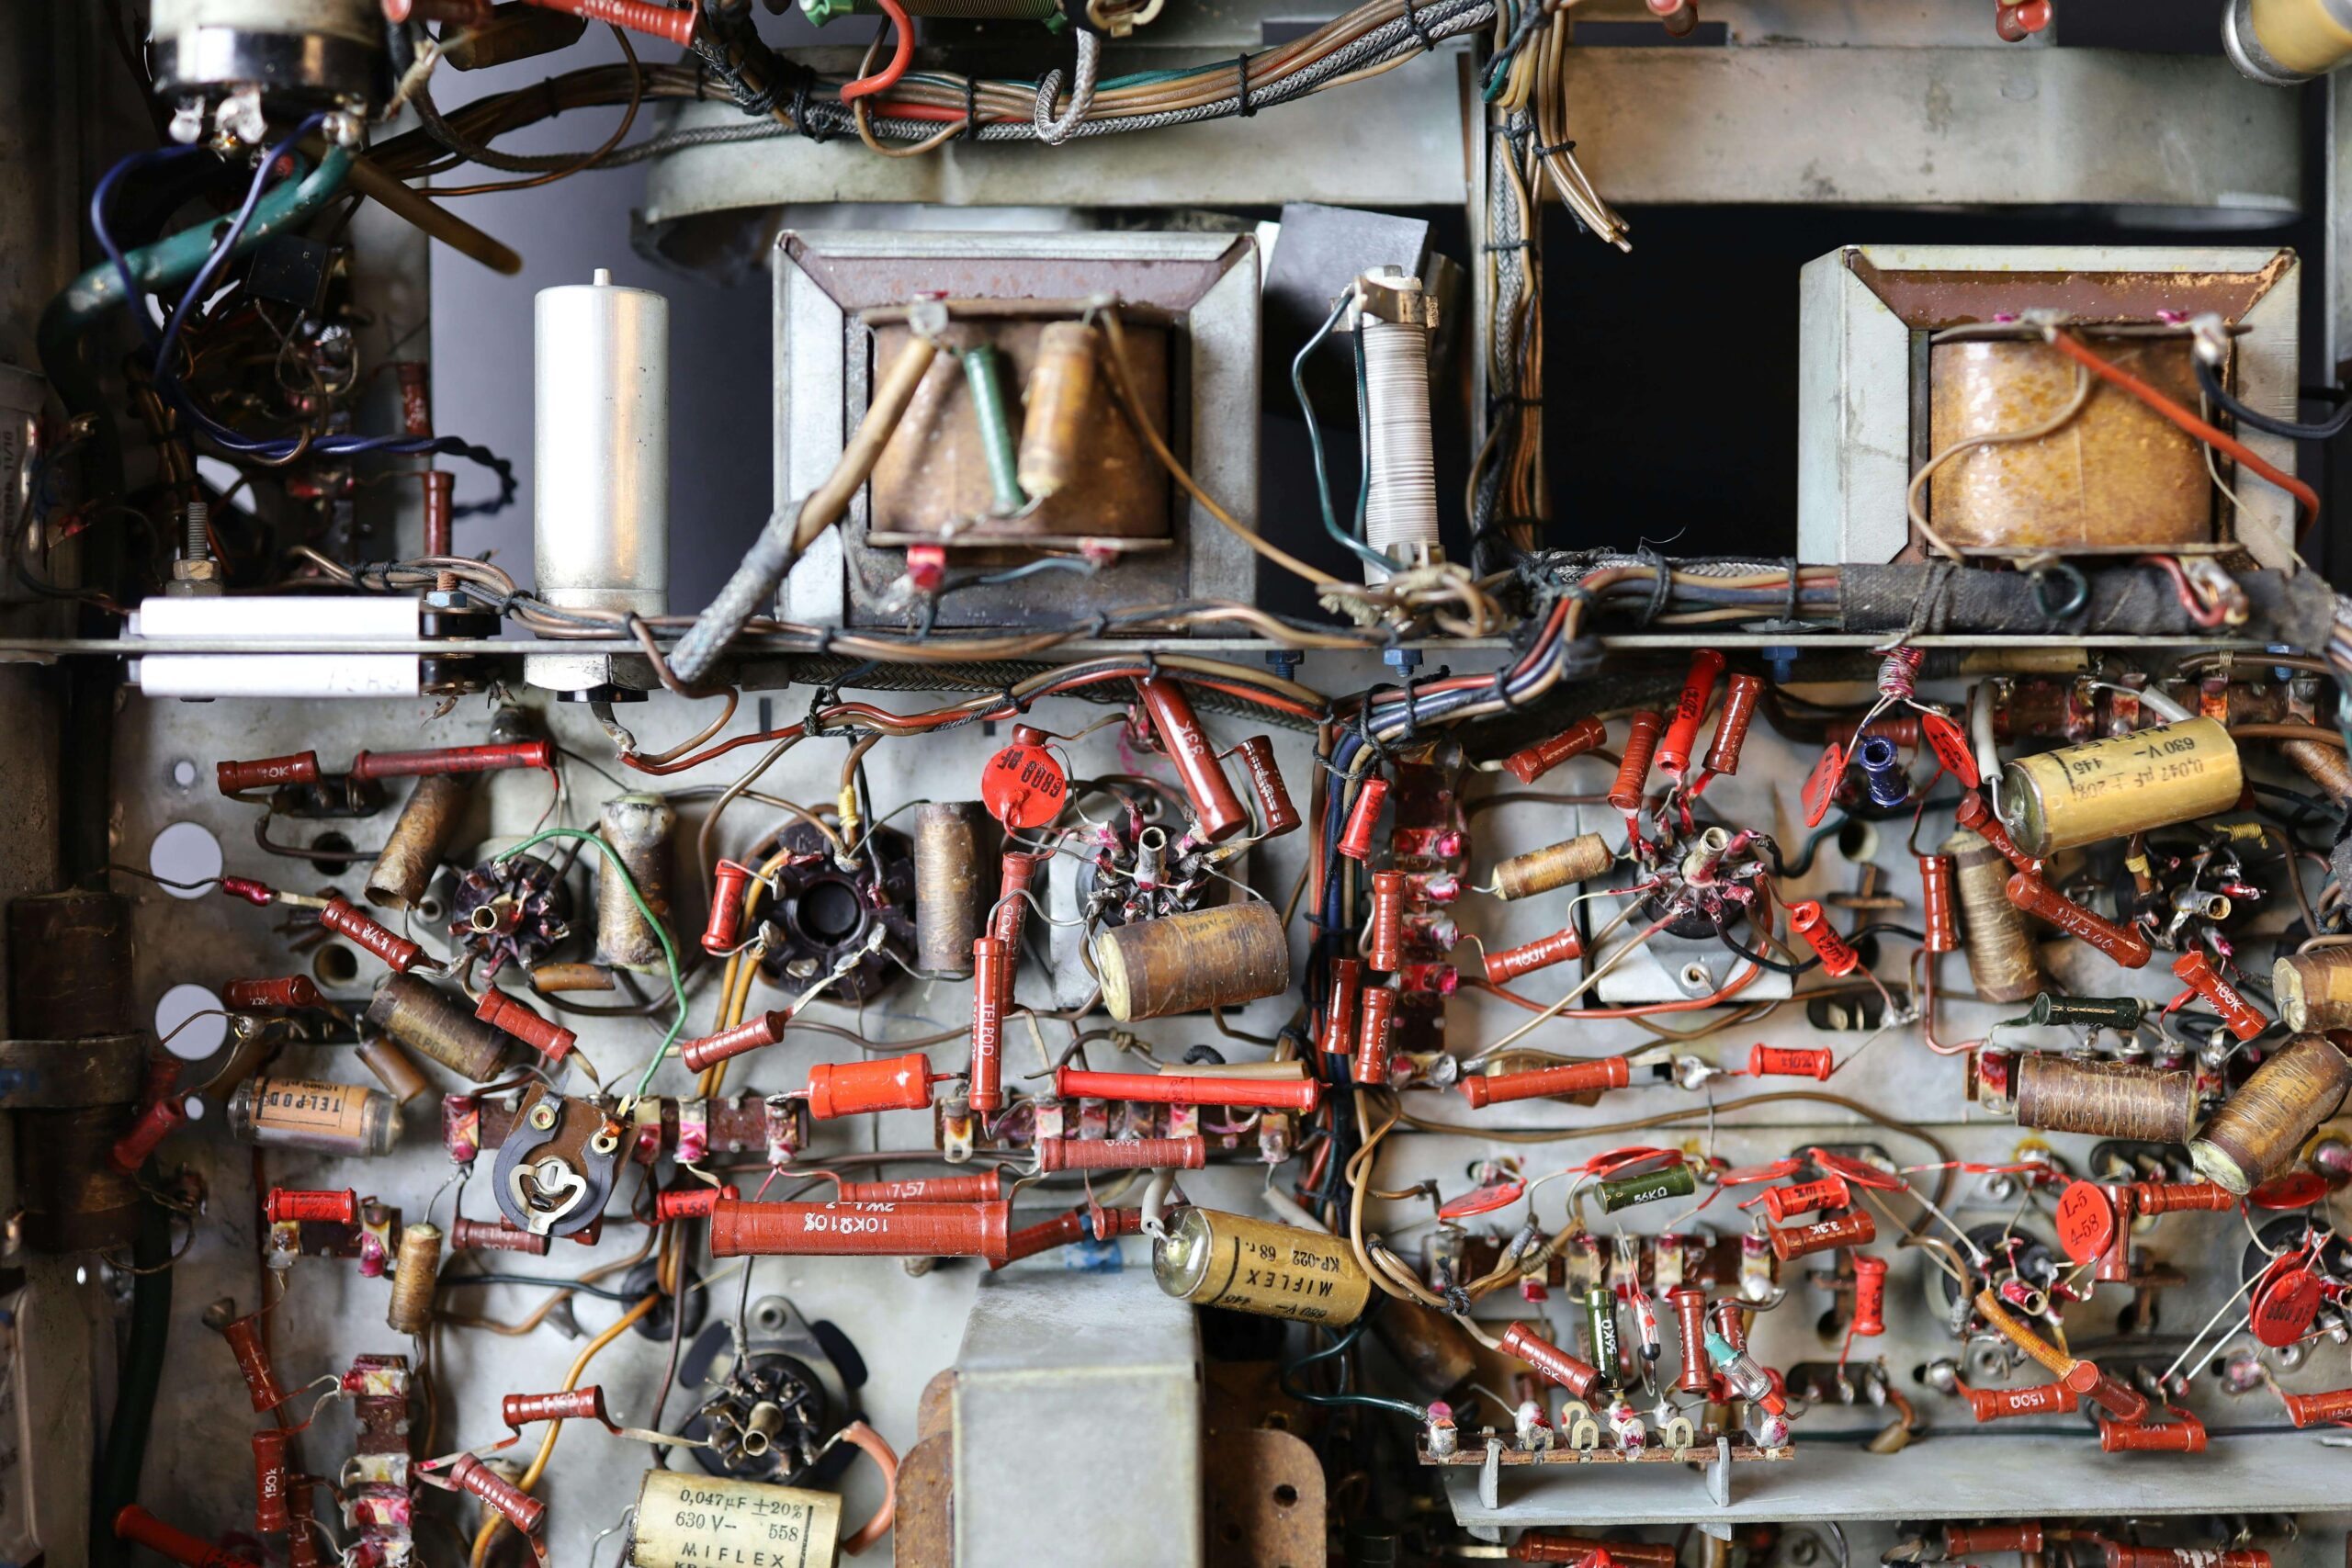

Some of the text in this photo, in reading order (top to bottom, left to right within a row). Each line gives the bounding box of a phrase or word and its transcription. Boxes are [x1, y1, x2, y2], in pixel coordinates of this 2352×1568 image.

[2164, 736, 2195, 755] 630
[2072, 757, 2103, 773] 445
[981, 1002, 994, 1055] TELPOD
[268, 1090, 341, 1113] TELPOD
[1634, 1186, 1668, 1204] 56KΩ
[2064, 1190, 2086, 1215] L-5
[1808, 1218, 1840, 1235] 3.3K
[2071, 1215, 2099, 1246] 4-58
[1258, 1243, 1277, 1258] 68
[1246, 1269, 1332, 1295] MIFLEX
[1601, 1318, 1617, 1354] 56KΩ
[2009, 1392, 2044, 1408] 150Ω
[674, 1511, 707, 1530] 630
[767, 1523, 799, 1542] 558
[681, 1542, 785, 1568] MIFLEX
